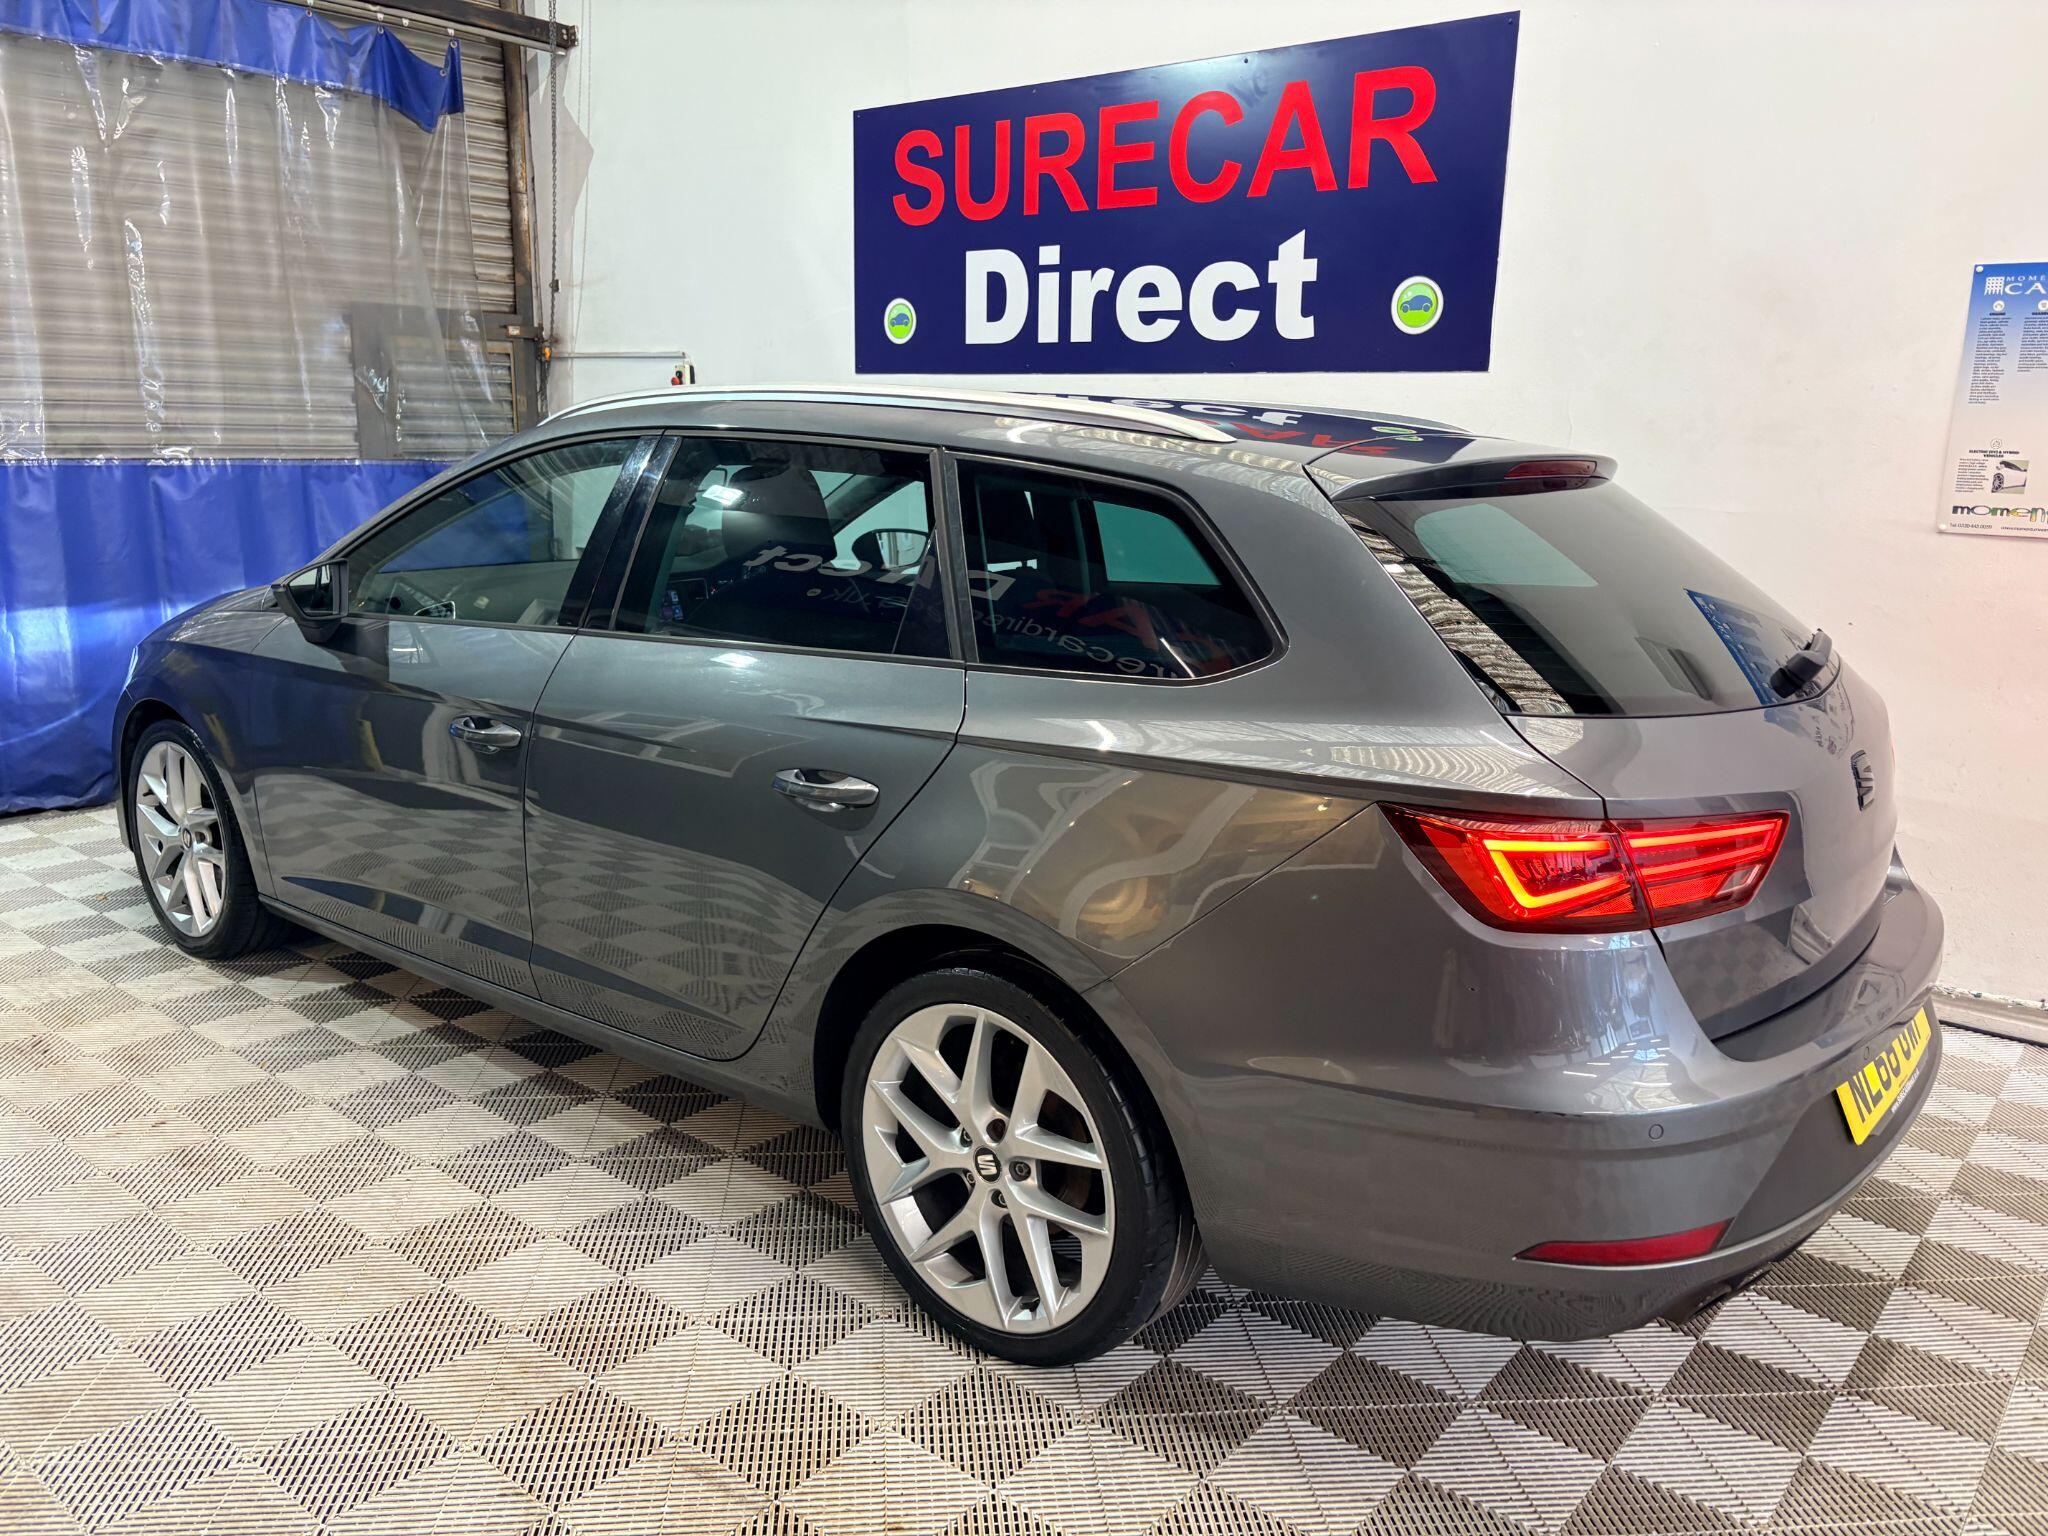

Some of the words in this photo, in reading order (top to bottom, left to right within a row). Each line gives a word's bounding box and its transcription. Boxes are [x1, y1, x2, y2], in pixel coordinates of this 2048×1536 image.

[892, 65, 1438, 226] SURECAR
[965, 228, 1318, 345] Direct
[1952, 505, 2048, 522] momen
